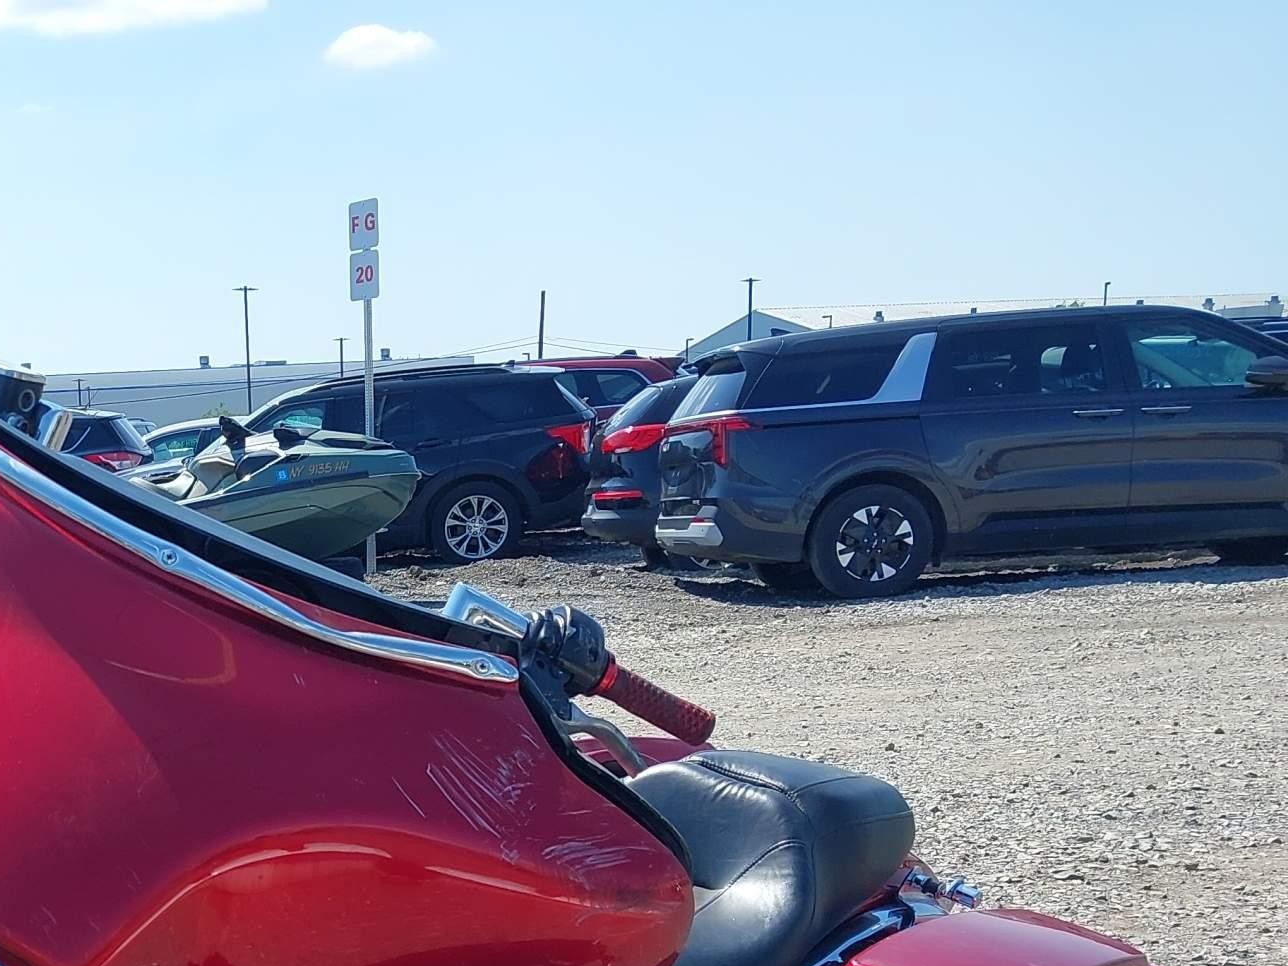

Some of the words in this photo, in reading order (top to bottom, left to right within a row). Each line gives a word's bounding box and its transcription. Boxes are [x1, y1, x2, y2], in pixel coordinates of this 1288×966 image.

[351, 216, 359, 233] F
[364, 212, 375, 231] G
[355, 265, 373, 284] 20
